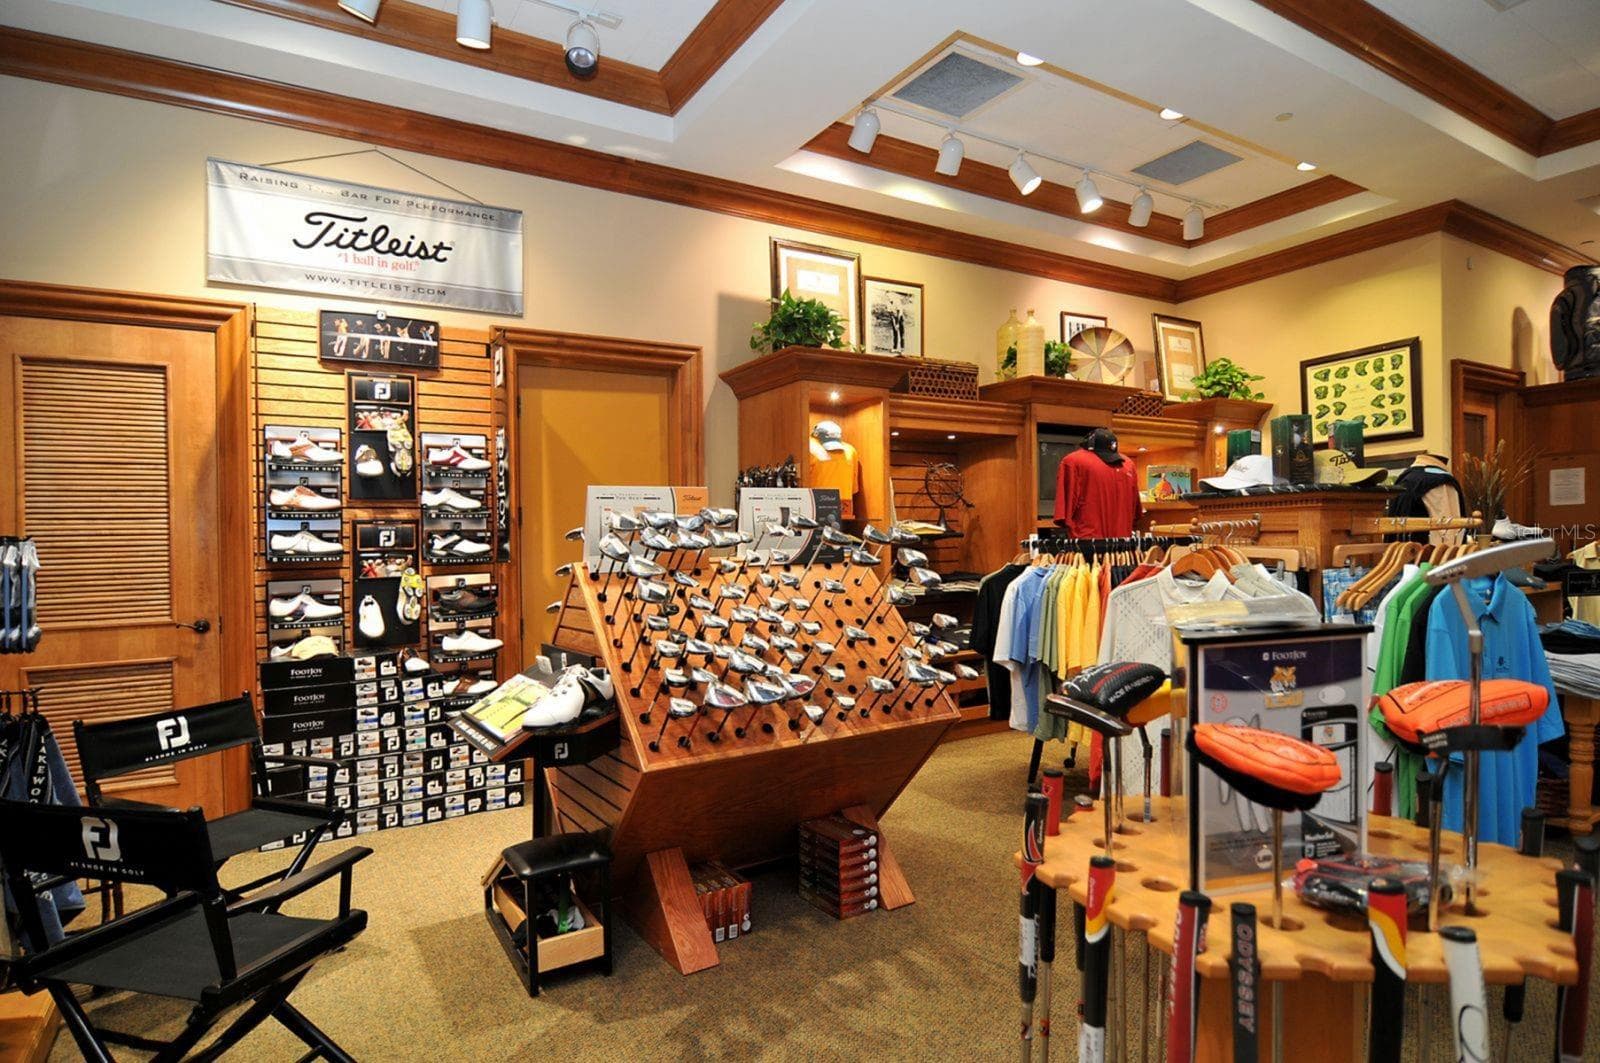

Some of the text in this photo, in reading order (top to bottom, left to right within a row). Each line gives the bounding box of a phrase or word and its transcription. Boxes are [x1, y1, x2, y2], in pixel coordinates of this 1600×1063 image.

[239, 172, 299, 190] RAISING
[341, 190, 368, 200] BAR
[375, 195, 400, 206] FOR
[293, 211, 453, 263] Titleist
[353, 253, 375, 267] ball
[377, 257, 389, 269] in
[304, 273, 447, 297] WWW.TITLEIST.COM
[379, 530, 395, 547] FJ
[156, 715, 190, 750] FJ
[554, 742, 569, 760] FJ
[80, 816, 121, 862] FJ
[1236, 923, 1255, 1034] ODYSSEY
